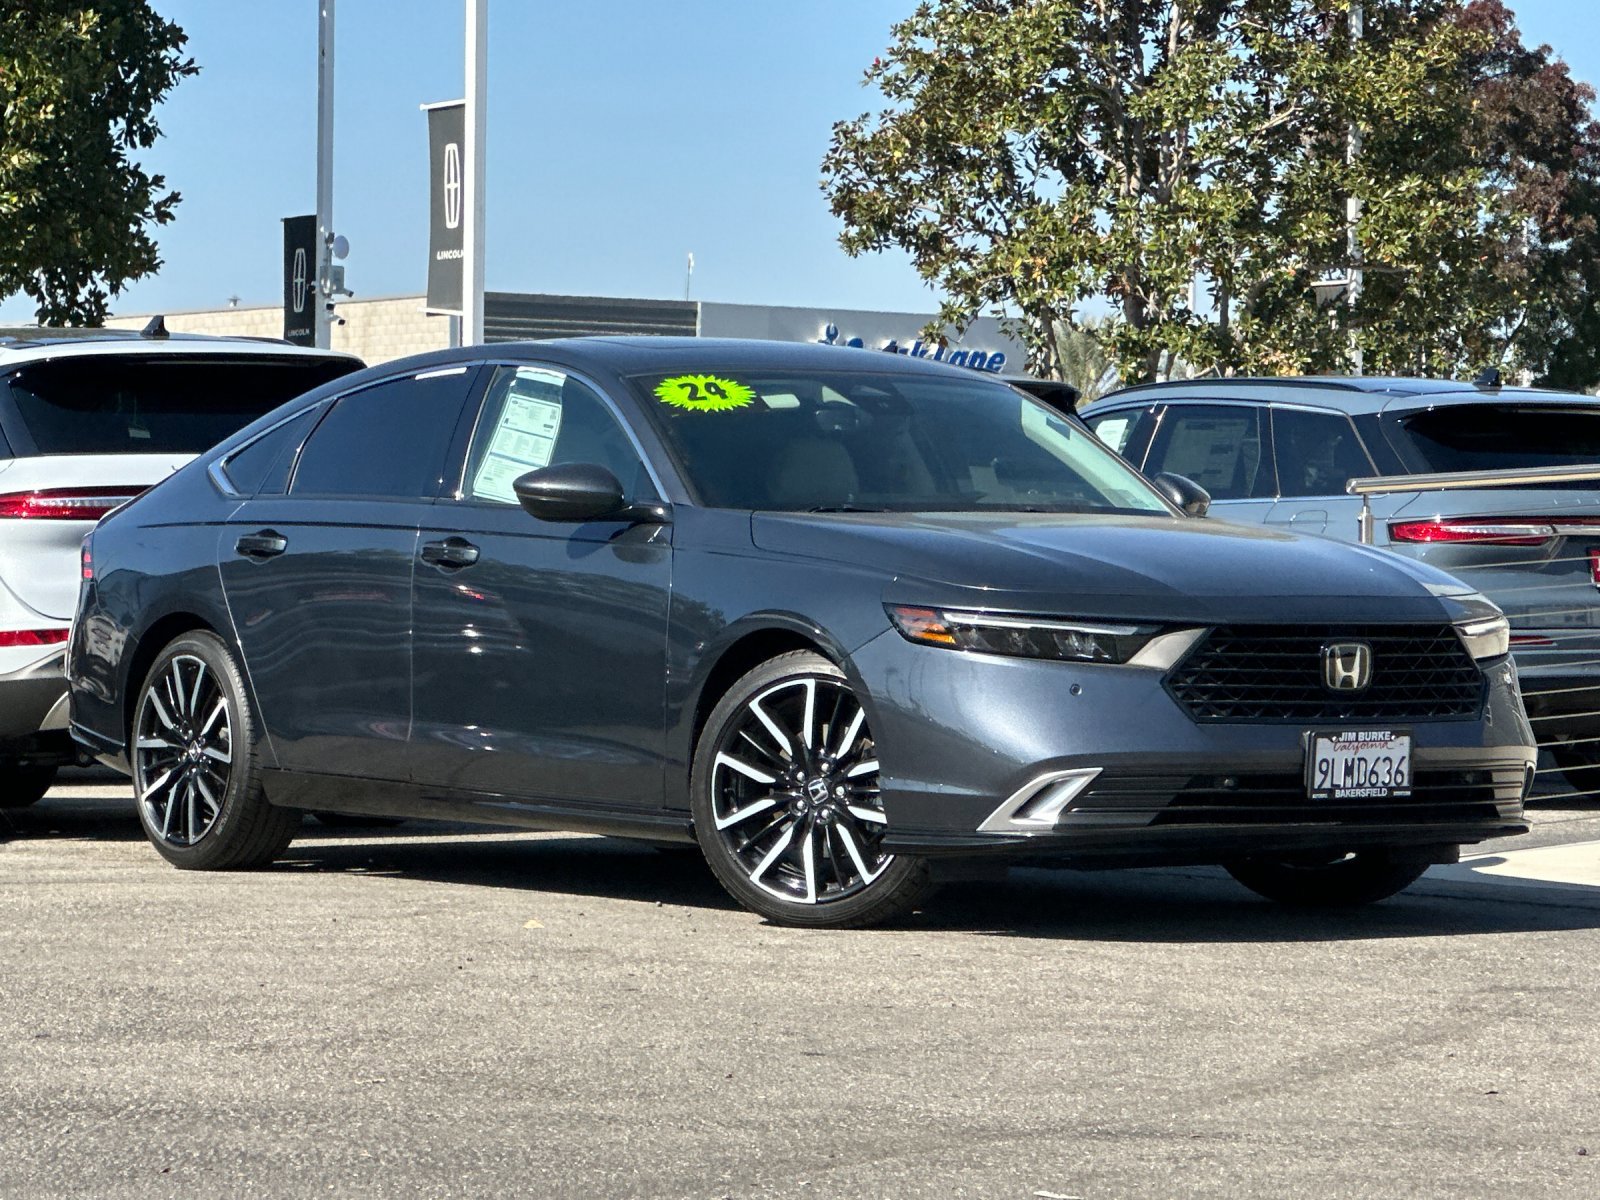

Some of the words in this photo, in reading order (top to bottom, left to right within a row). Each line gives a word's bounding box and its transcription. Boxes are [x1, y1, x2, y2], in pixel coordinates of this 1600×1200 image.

[287, 328, 310, 337] LINCOLN
[1339, 732, 1357, 742] JIM
[1357, 731, 1392, 741] BURKE
[1333, 741, 1394, 755] California
[1317, 756, 1407, 789] 9LMD636
[1335, 788, 1388, 798] BAKERSFIELD
